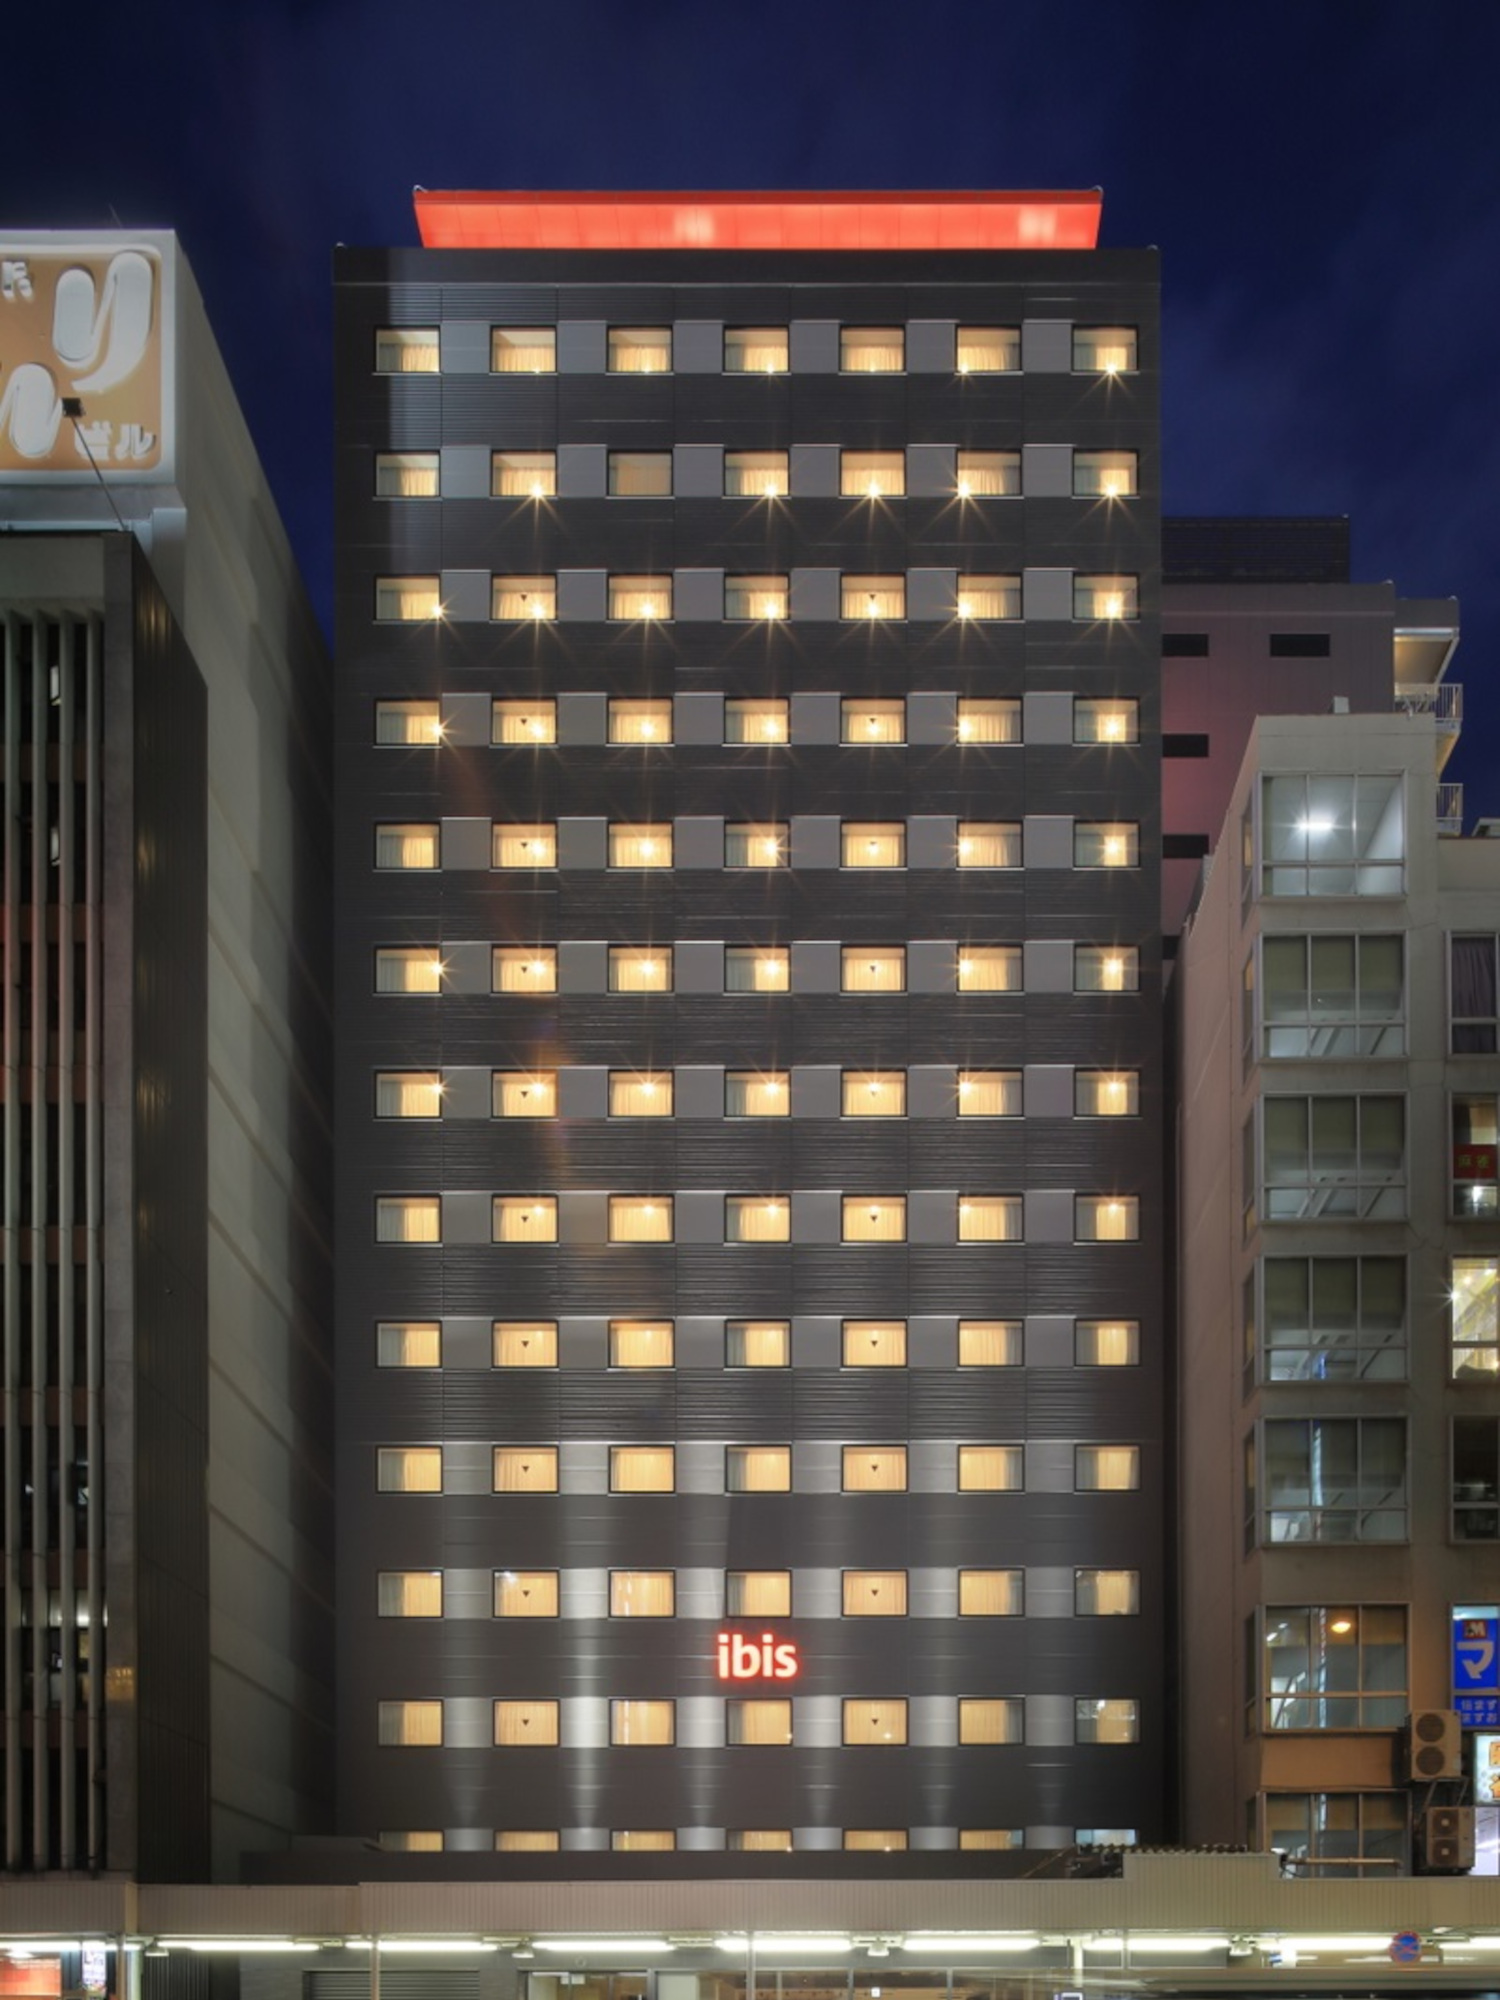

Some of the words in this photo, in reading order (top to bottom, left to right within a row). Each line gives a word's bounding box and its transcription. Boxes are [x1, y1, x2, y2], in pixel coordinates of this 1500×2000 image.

[74, 420, 156, 461] ビル
[718, 1633, 798, 1679] ibis
[1457, 1641, 1494, 1680] マ
